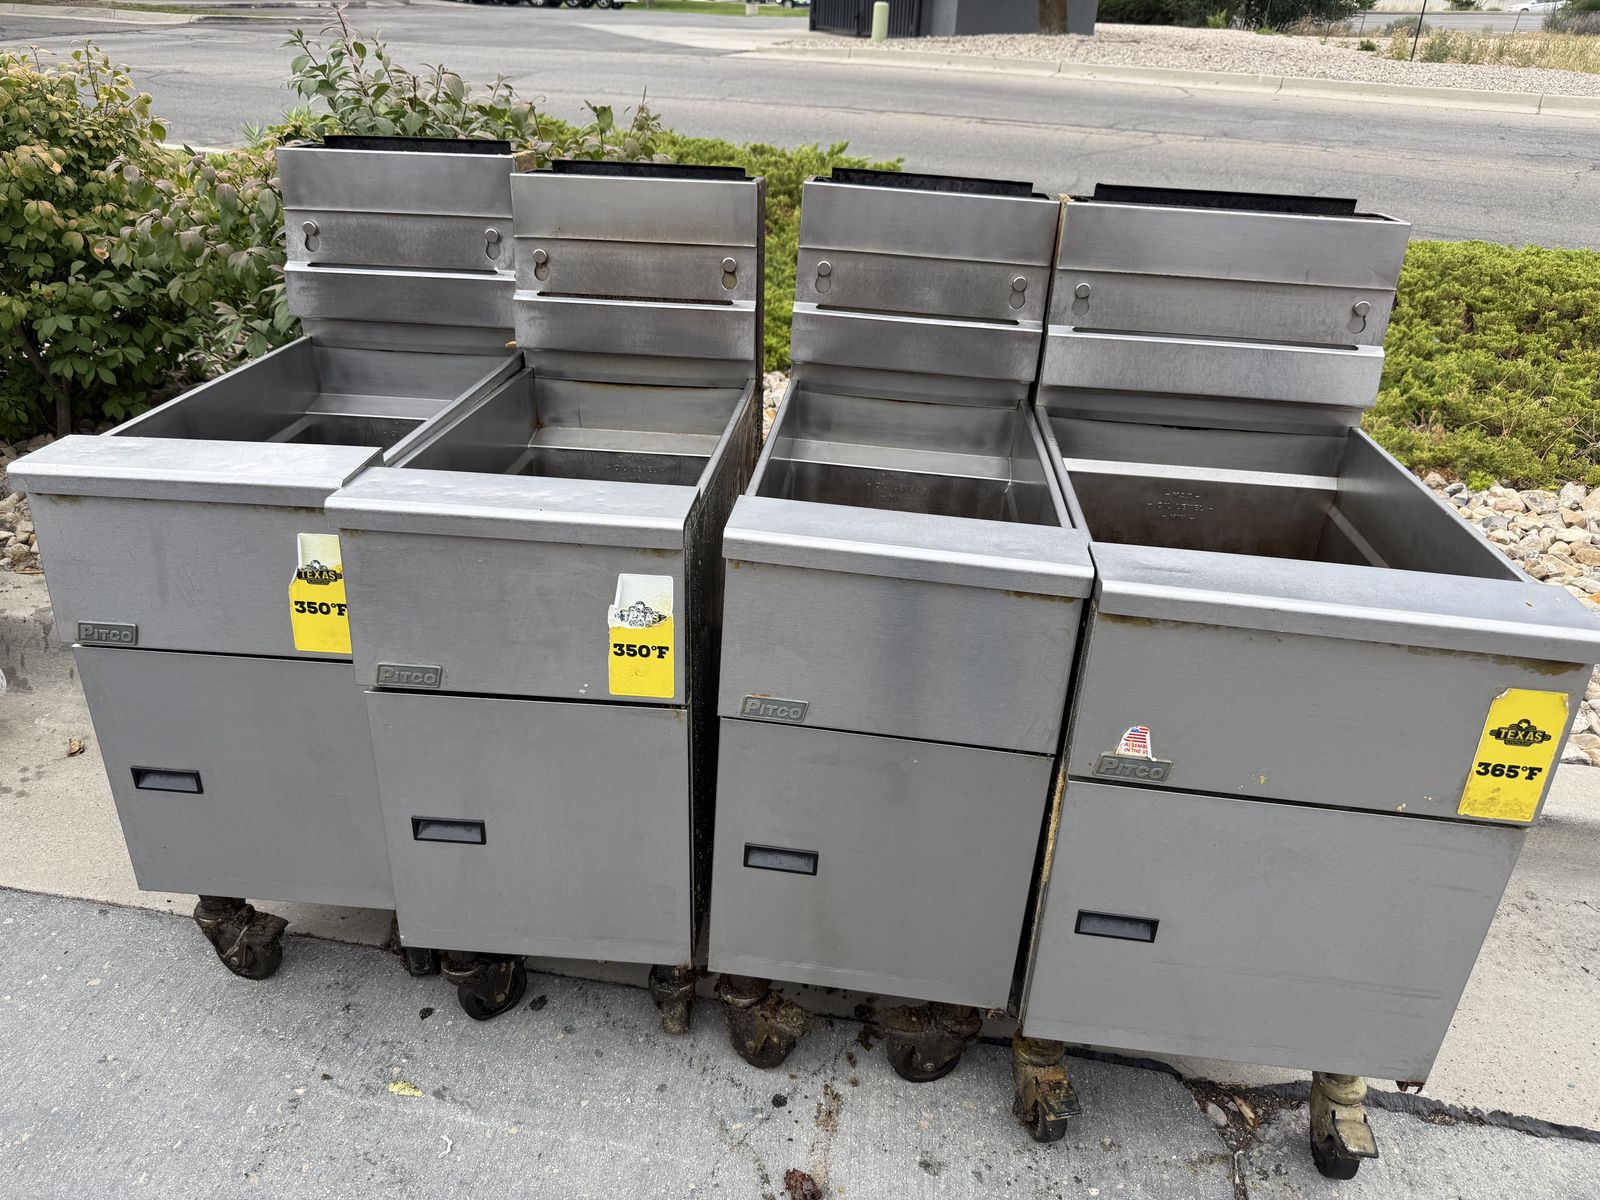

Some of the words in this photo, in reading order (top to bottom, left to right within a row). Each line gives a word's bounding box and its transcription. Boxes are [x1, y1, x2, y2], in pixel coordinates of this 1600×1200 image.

[300, 569, 336, 580] TEXAS
[294, 600, 347, 616] 350°F
[613, 643, 669, 659] 350°F
[1500, 729, 1543, 741] TEXAS
[1475, 762, 1542, 781] 365°F
